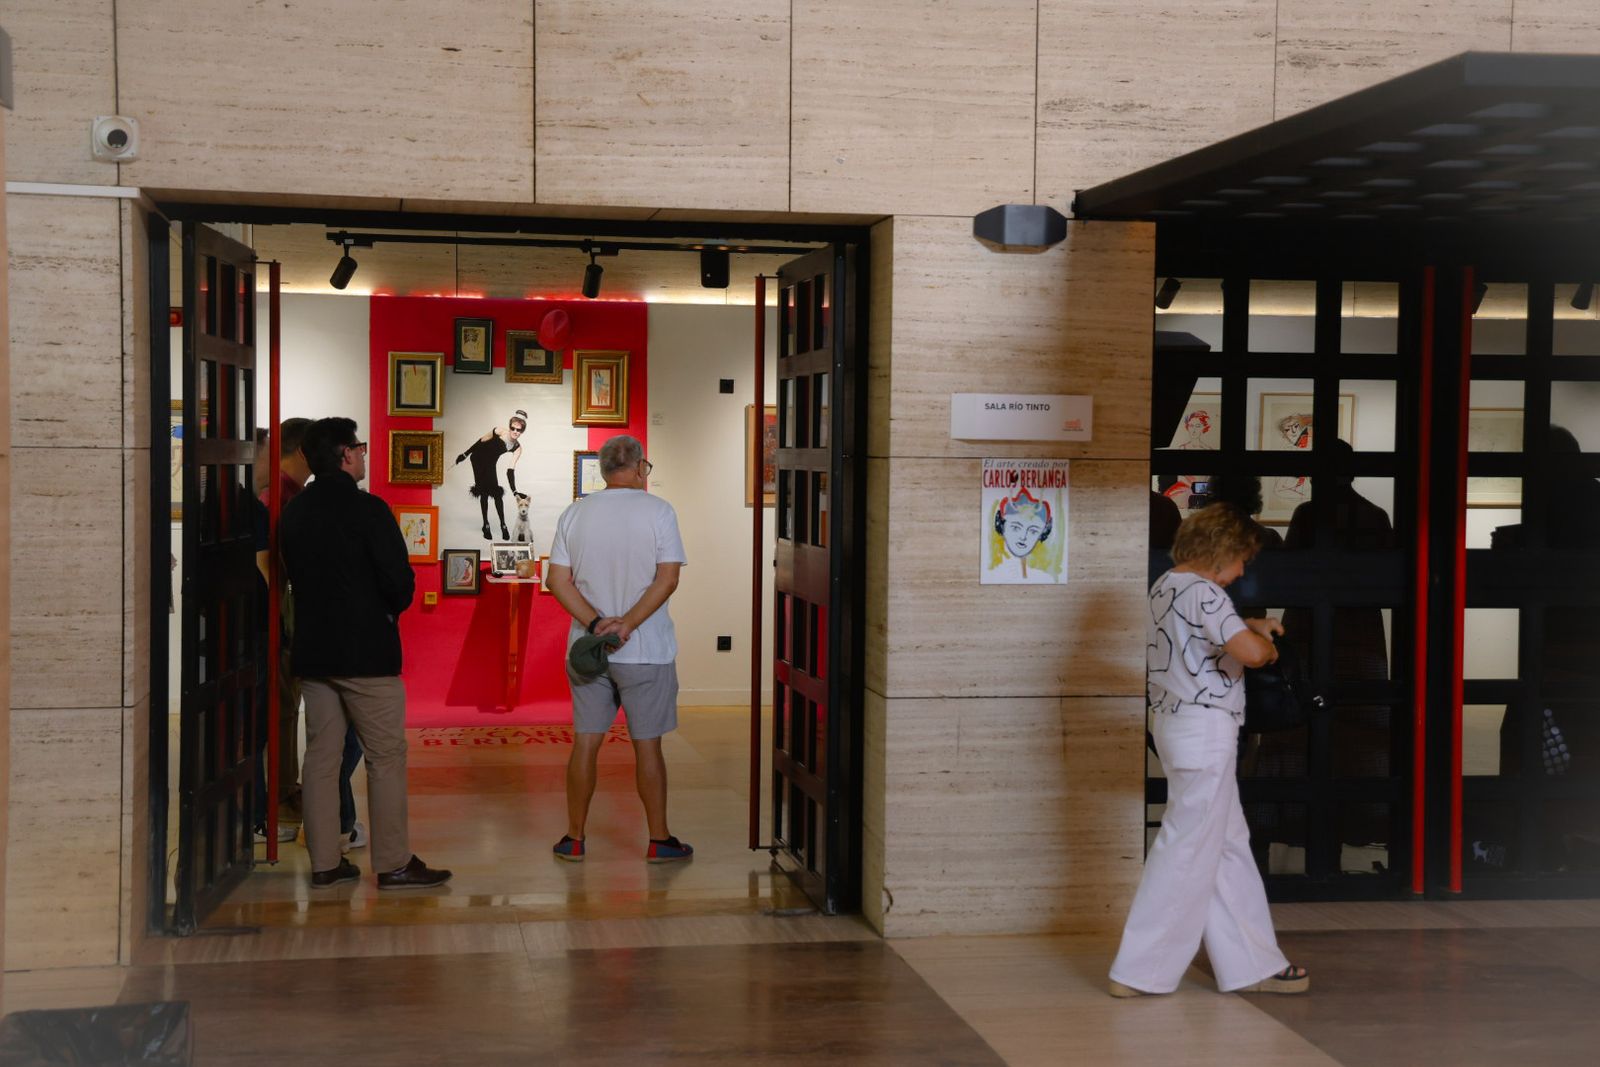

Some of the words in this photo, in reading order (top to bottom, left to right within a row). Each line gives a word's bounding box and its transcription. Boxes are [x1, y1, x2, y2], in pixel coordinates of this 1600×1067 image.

[984, 402, 1007, 411] SALA
[1008, 401, 1024, 411] RÍO
[1025, 403, 1051, 412] TINTO
[983, 459, 994, 467] El
[997, 460, 1015, 468] arte
[1018, 460, 1050, 468] creado
[1053, 461, 1068, 469] por
[983, 469, 1019, 488] CARLOS
[1020, 469, 1067, 488] BERLANGA
[487, 730, 626, 738] CARLS
[423, 737, 630, 746] BERLANA
